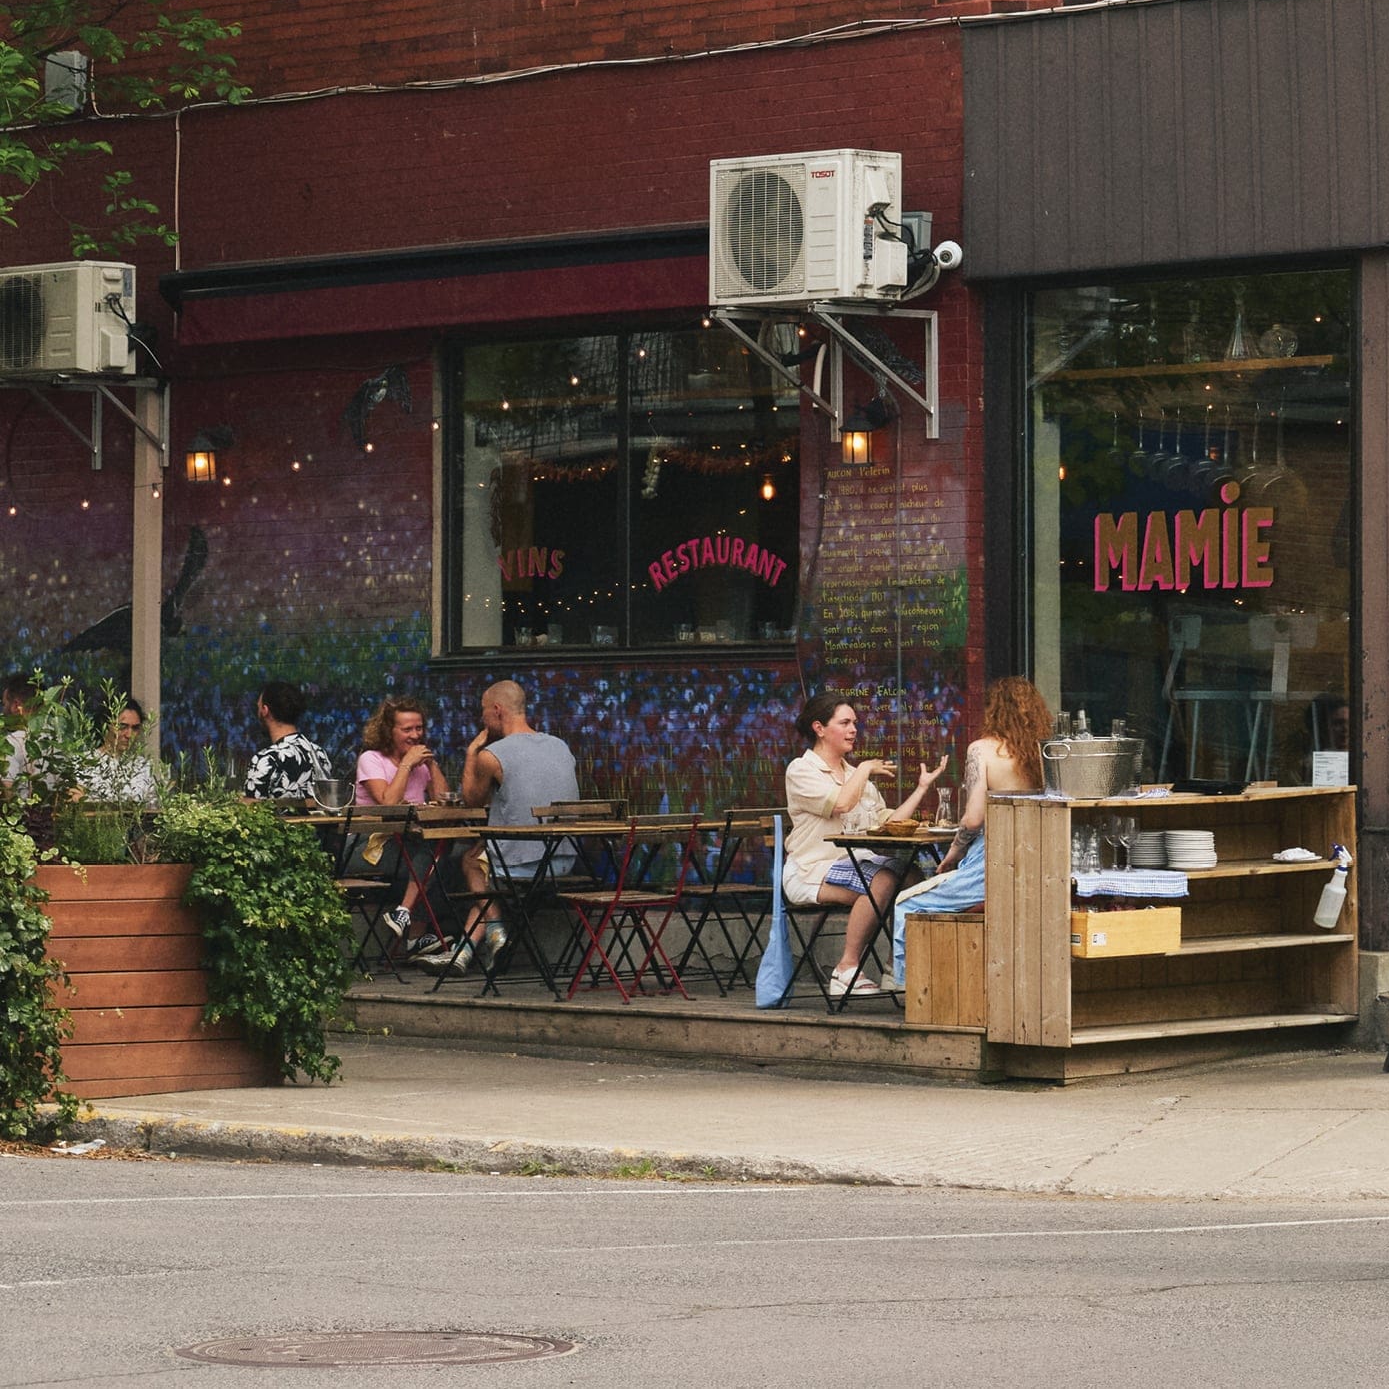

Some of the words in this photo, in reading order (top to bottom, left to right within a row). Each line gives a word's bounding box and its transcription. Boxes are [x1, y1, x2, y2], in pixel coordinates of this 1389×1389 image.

[810, 170, 835, 179] TOSOT
[497, 546, 566, 582] VINS
[649, 536, 787, 592] RESTAURANT
[824, 609, 833, 618] En
